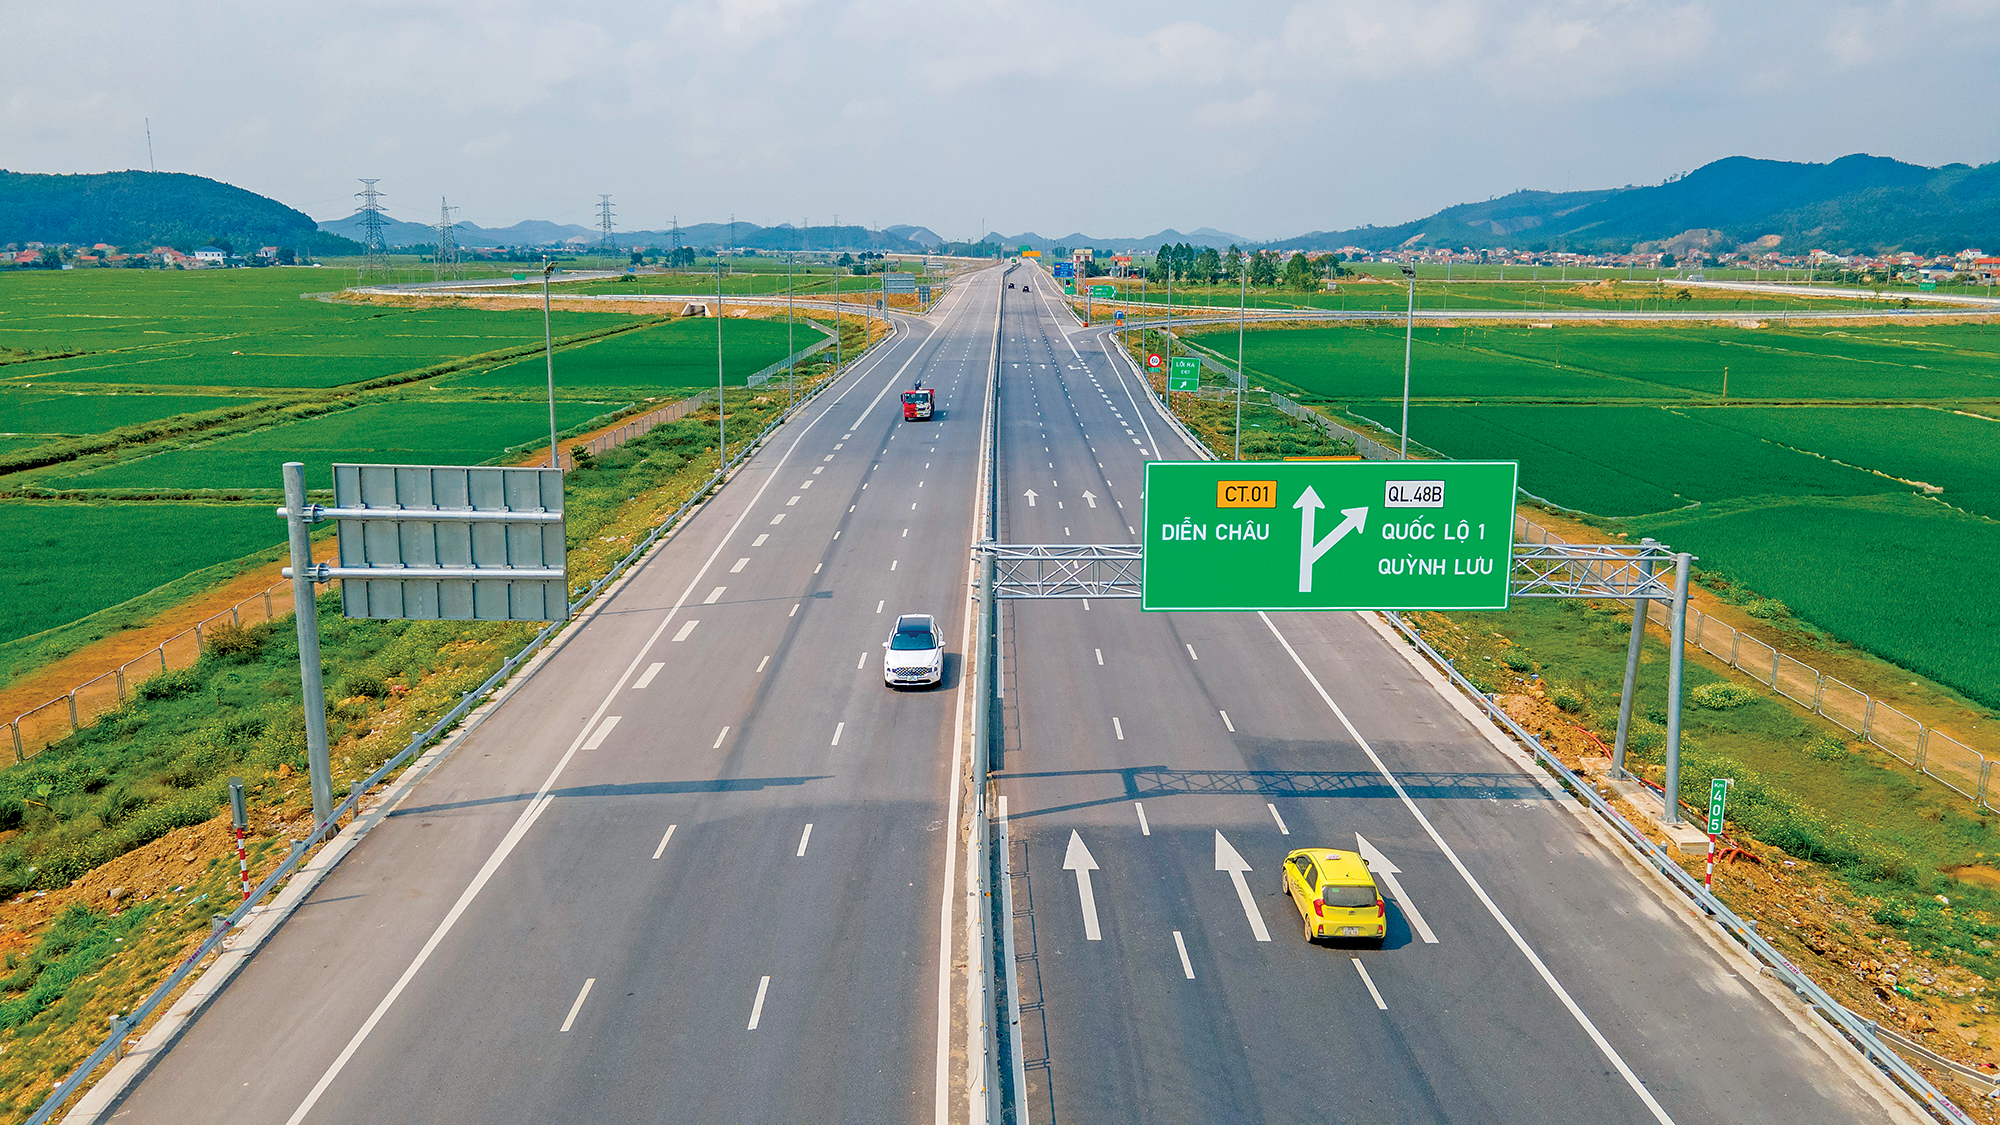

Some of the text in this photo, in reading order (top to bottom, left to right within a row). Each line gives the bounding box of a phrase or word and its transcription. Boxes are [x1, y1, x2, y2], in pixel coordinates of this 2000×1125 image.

[1225, 485, 1269, 502] CT.01
[1388, 485, 1442, 503] QL.48B
[1161, 516, 1270, 541] DIỄN CHÂU
[1381, 514, 1485, 544] QUỐC LỘ 1
[1378, 553, 1493, 576] QUỲNH LƯU
